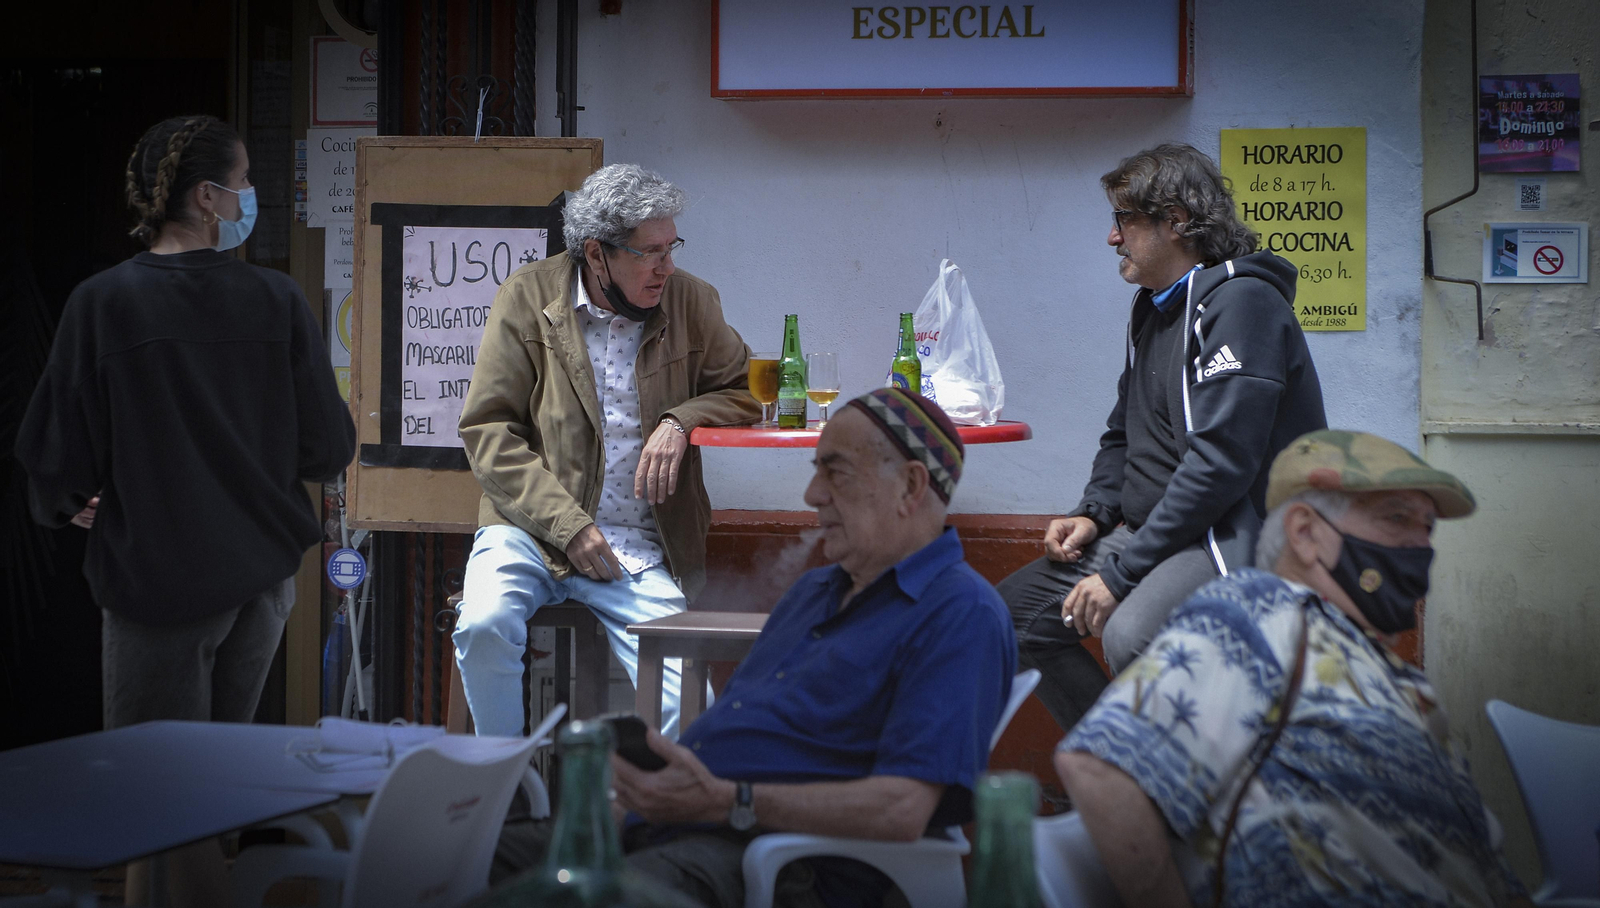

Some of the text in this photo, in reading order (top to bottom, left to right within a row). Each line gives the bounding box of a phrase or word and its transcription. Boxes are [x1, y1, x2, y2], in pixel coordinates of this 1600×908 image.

[851, 5, 1045, 39] ESPECIAL
[1497, 91, 1527, 99] Martes
[1526, 104, 1534, 113] a
[1500, 117, 1564, 136] Domingo
[1241, 143, 1343, 165] HORARIO
[1527, 143, 1535, 152] a
[333, 160, 348, 175] de
[328, 182, 343, 197] de
[1250, 173, 1336, 196] de 8 a 17 h.
[1241, 200, 1343, 222] HORARIO
[1268, 232, 1354, 252] COCINA
[429, 240, 511, 287] USO
[1300, 261, 1352, 283] 6,30 h.
[1300, 303, 1357, 316] AMBIGÚ
[1300, 316, 1347, 327] desde 1988
[1203, 361, 1242, 377] adidas
[403, 379, 471, 400] EL INT
[404, 415, 435, 435] DEL
